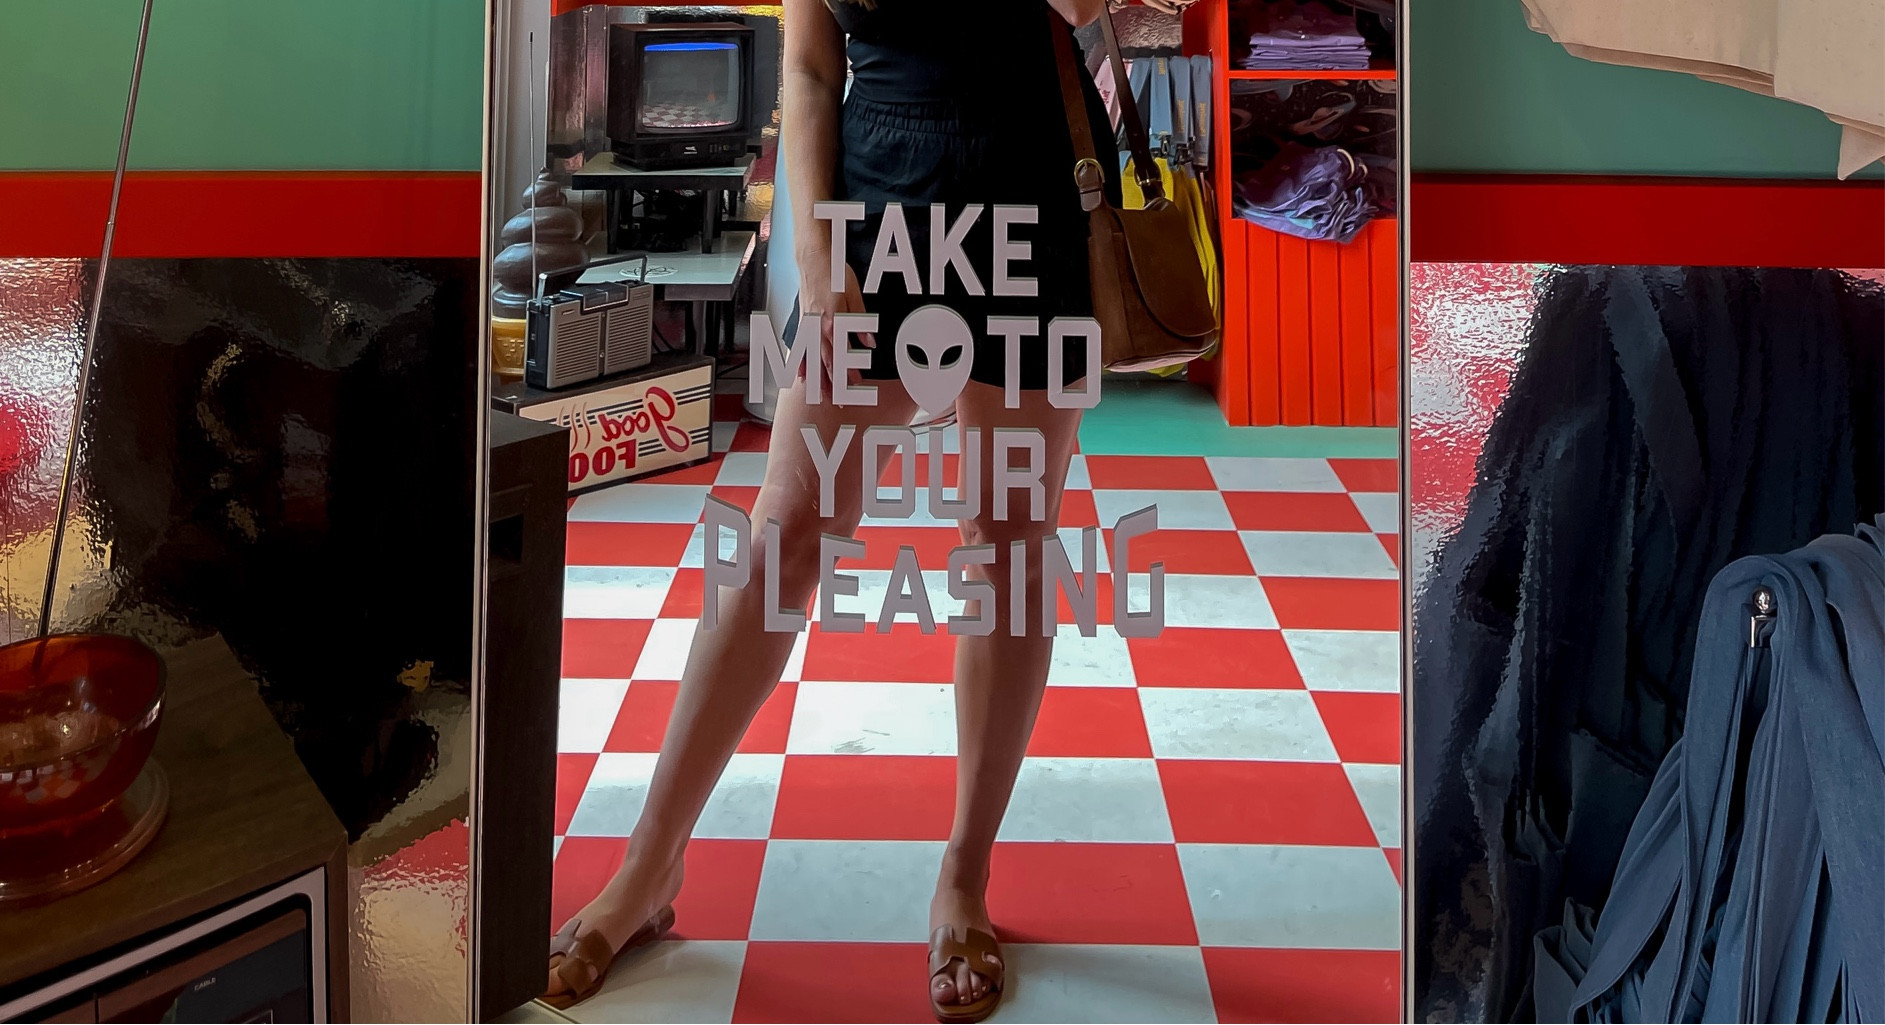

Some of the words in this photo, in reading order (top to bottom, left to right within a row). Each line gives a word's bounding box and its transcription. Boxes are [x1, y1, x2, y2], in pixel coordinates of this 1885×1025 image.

[813, 201, 1039, 297] TAKE
[748, 311, 879, 407] ME
[986, 314, 1102, 409] TO
[799, 424, 1046, 522] YOUR
[702, 493, 1166, 639] PLEASING
